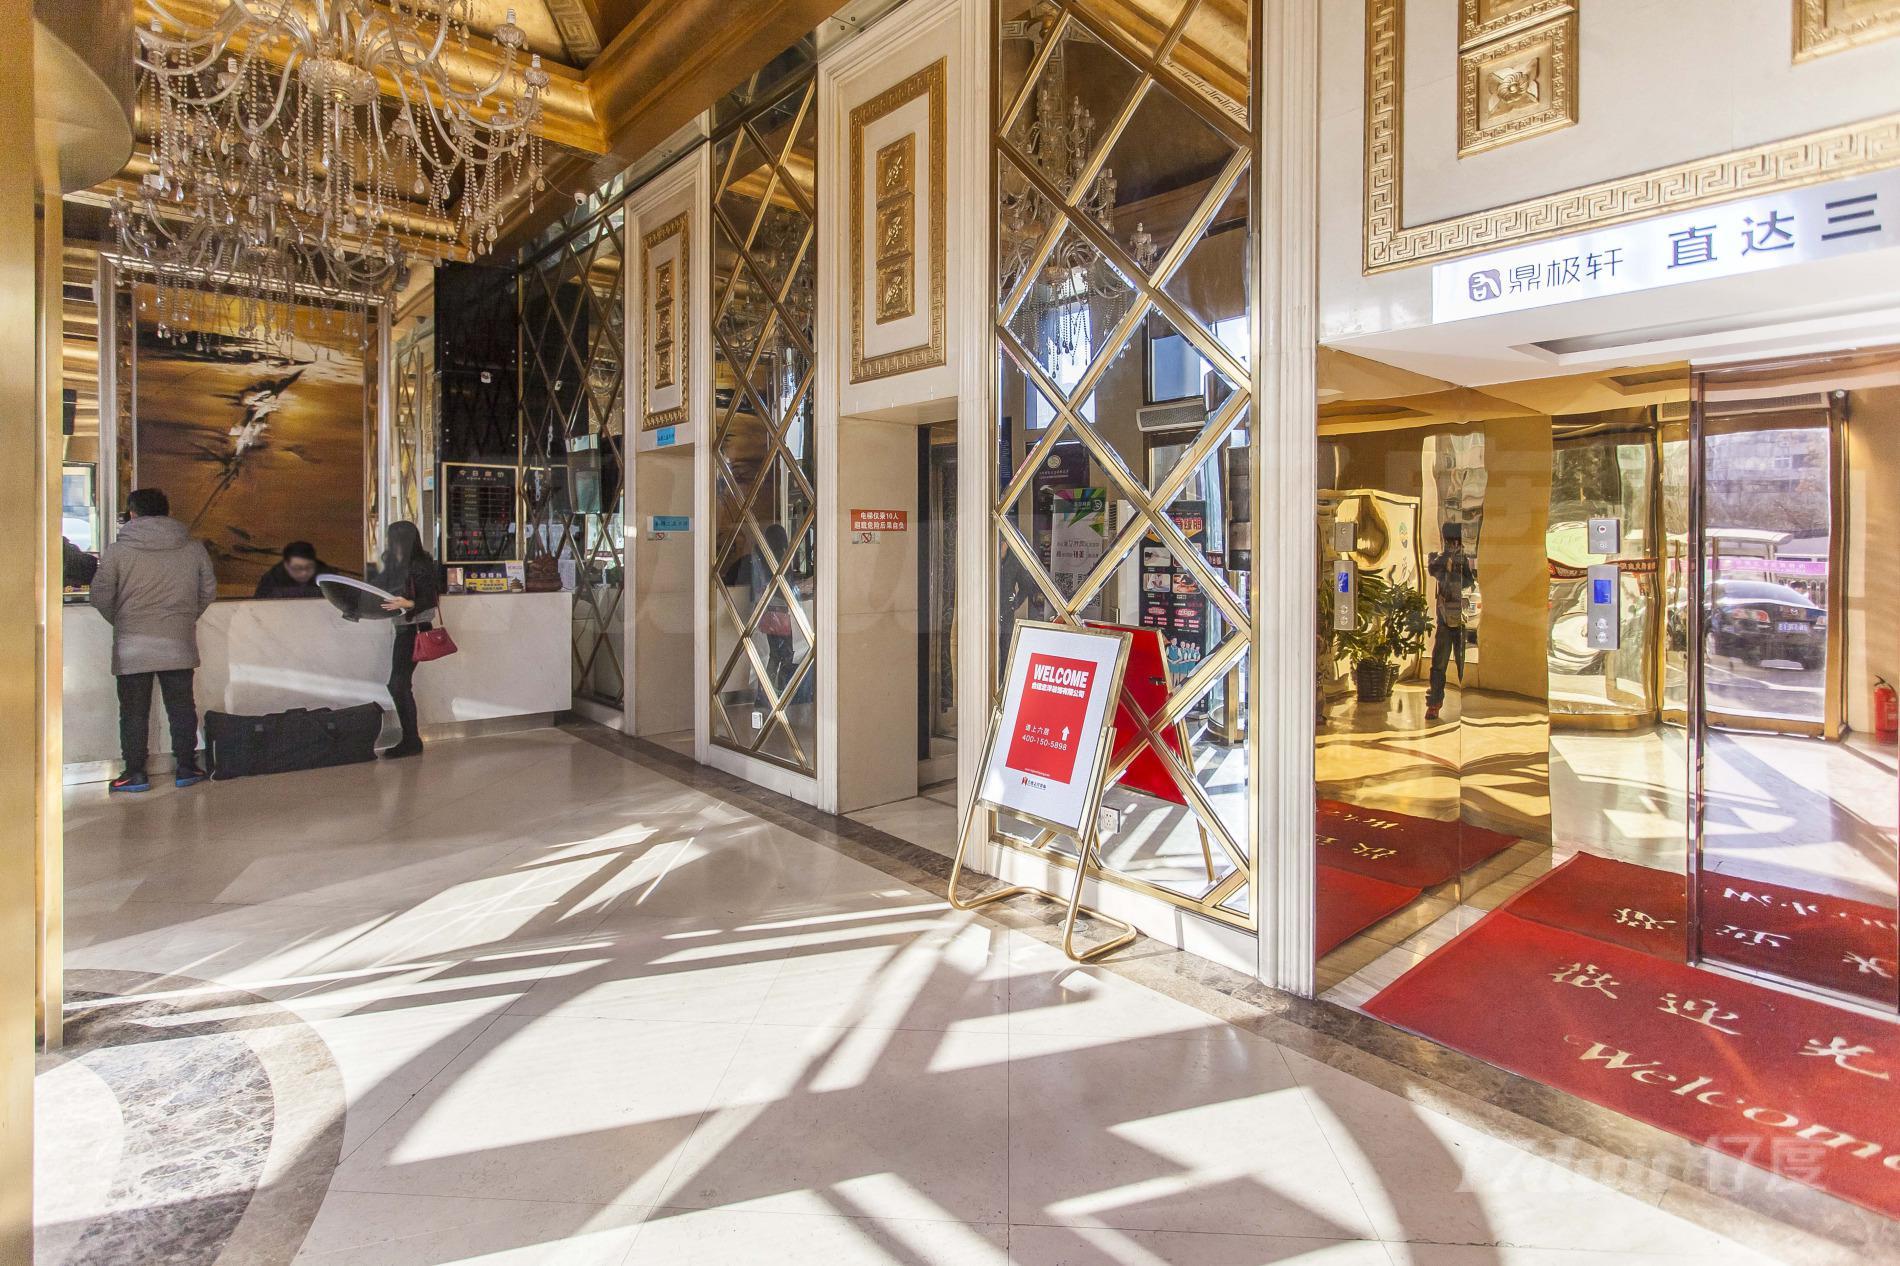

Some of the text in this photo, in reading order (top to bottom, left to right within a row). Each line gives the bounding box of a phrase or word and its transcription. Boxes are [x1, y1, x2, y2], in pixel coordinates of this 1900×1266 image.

[1508, 192, 1882, 295] 鼎极轩 直达三
[1033, 663, 1090, 689] WELCOME
